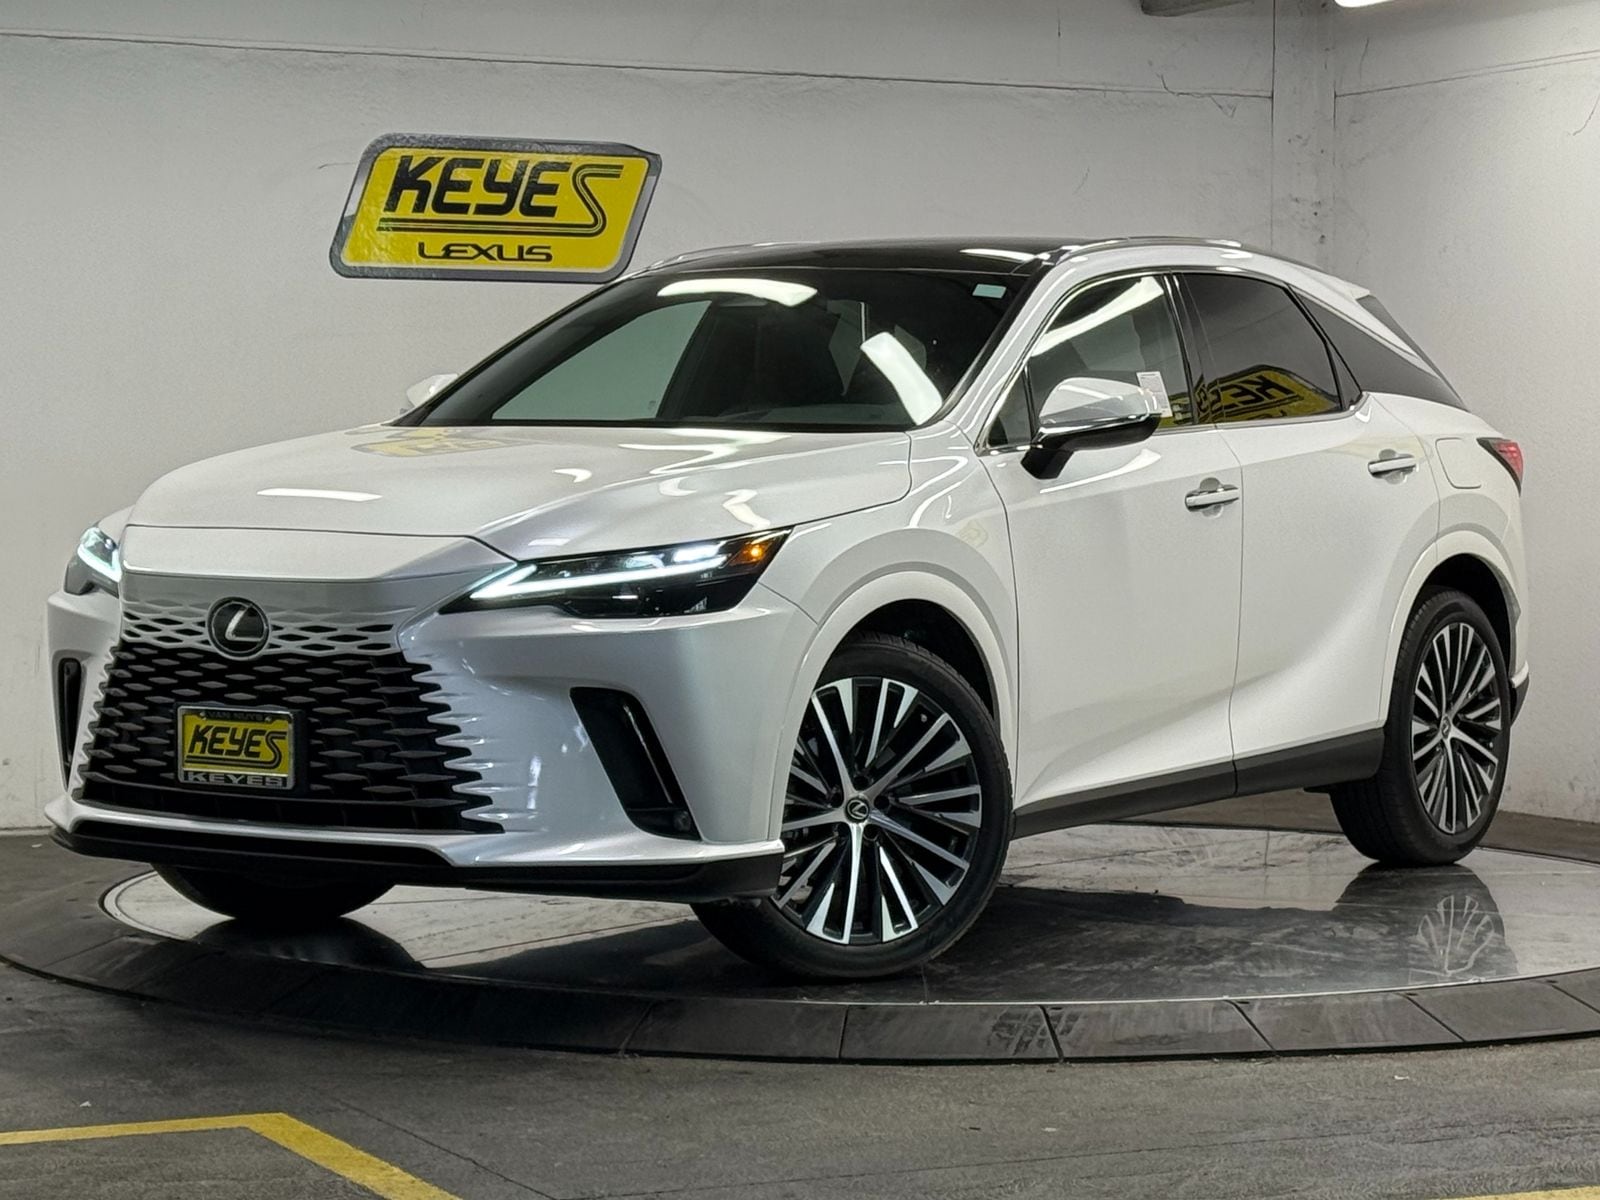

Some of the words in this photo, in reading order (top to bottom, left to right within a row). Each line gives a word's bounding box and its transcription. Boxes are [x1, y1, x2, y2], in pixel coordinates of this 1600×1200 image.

[377, 155, 624, 236] KEYES
[417, 241, 553, 262] LEXUS
[186, 724, 288, 769] KEYES
[187, 772, 283, 787] KEYES
